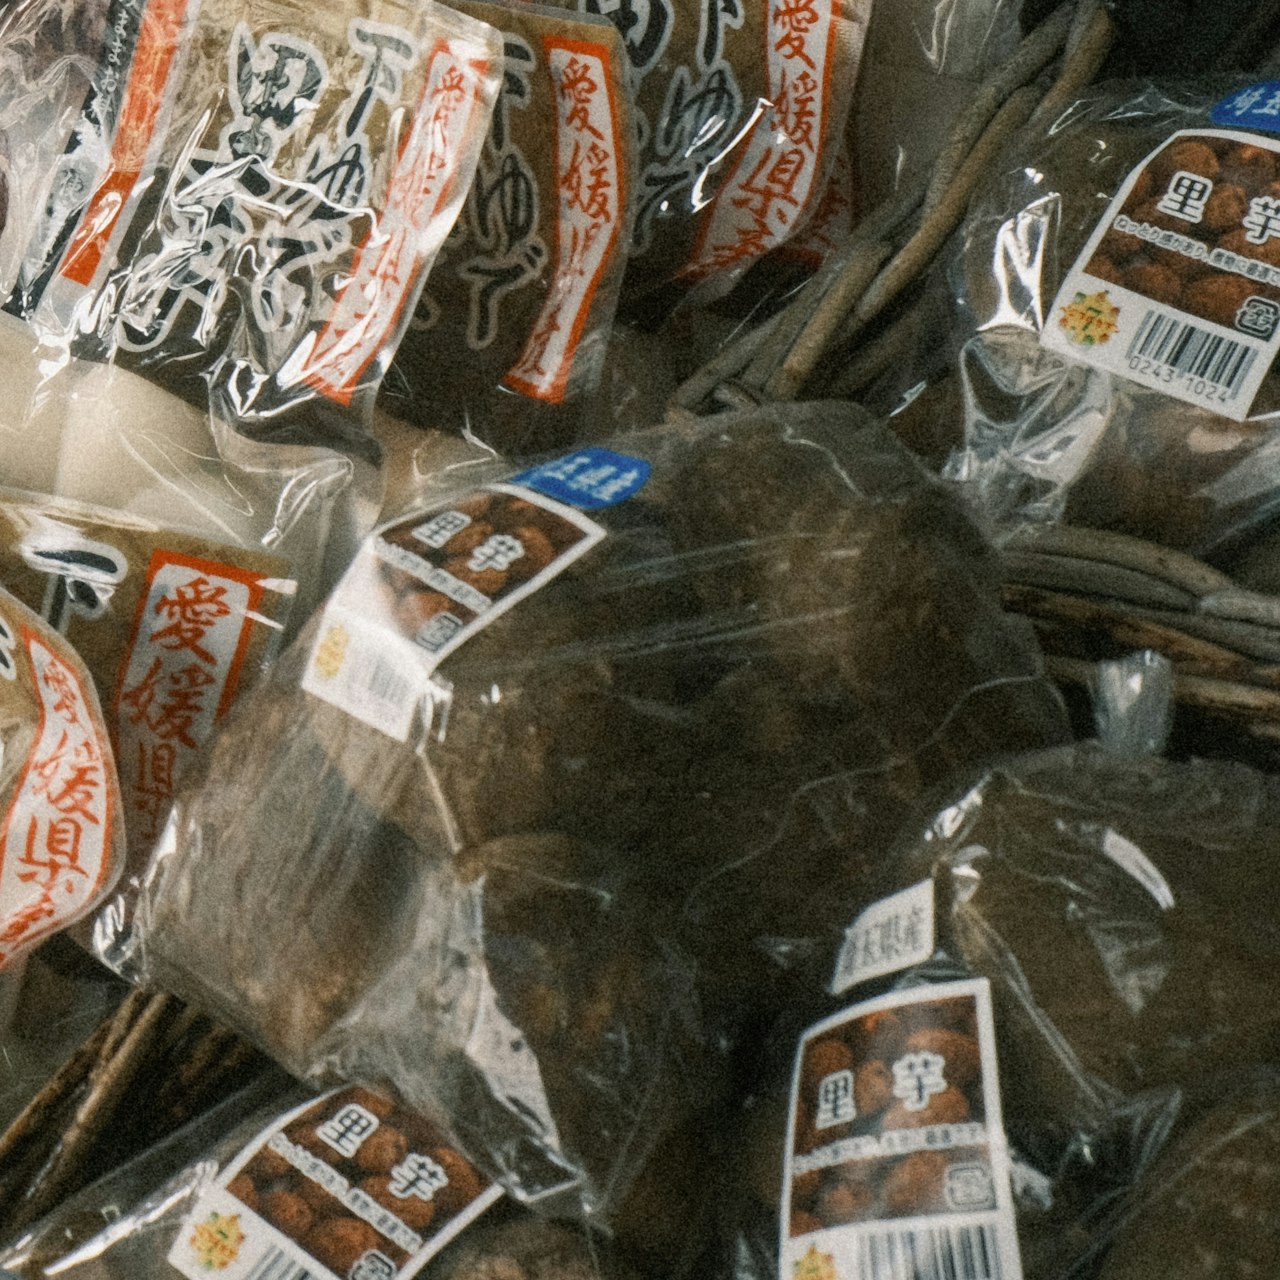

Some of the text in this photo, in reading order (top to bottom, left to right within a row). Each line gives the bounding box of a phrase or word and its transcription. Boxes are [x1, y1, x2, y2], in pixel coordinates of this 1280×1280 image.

[1157, 171, 1280, 245] 里芋
[1128, 355, 1228, 403] 0243 1024
[411, 509, 526, 573] 里芋
[816, 1055, 945, 1130] 里芋
[317, 1104, 449, 1201] 里芋
